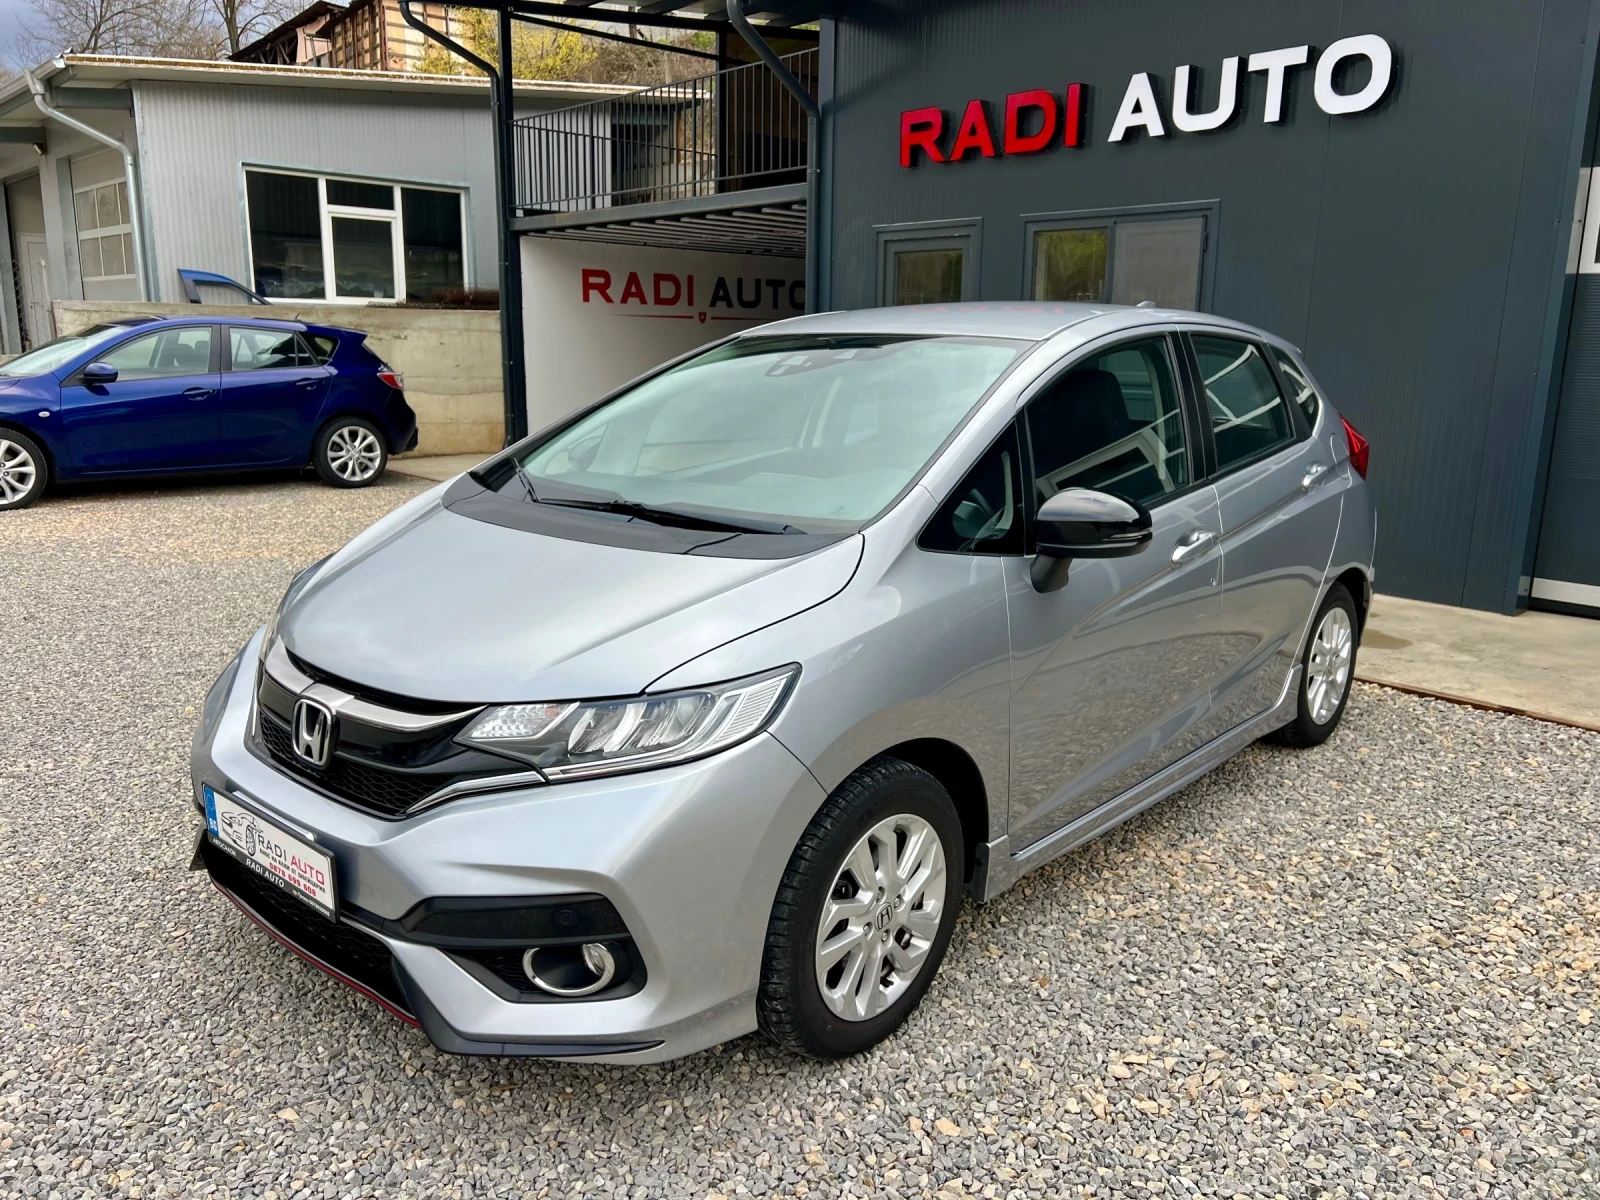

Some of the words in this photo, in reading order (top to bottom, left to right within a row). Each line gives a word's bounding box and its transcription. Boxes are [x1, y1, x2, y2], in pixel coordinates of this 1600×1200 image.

[900, 83, 1088, 168] RADI
[1107, 33, 1395, 143] AUTO
[582, 268, 694, 306] RADI
[709, 276, 806, 310] AUTO
[246, 858, 263, 874] RADI
[264, 870, 285, 889] AUTO
[257, 833, 287, 862] RADI
[290, 855, 325, 886] AUTO
[269, 861, 286, 878] 0878
